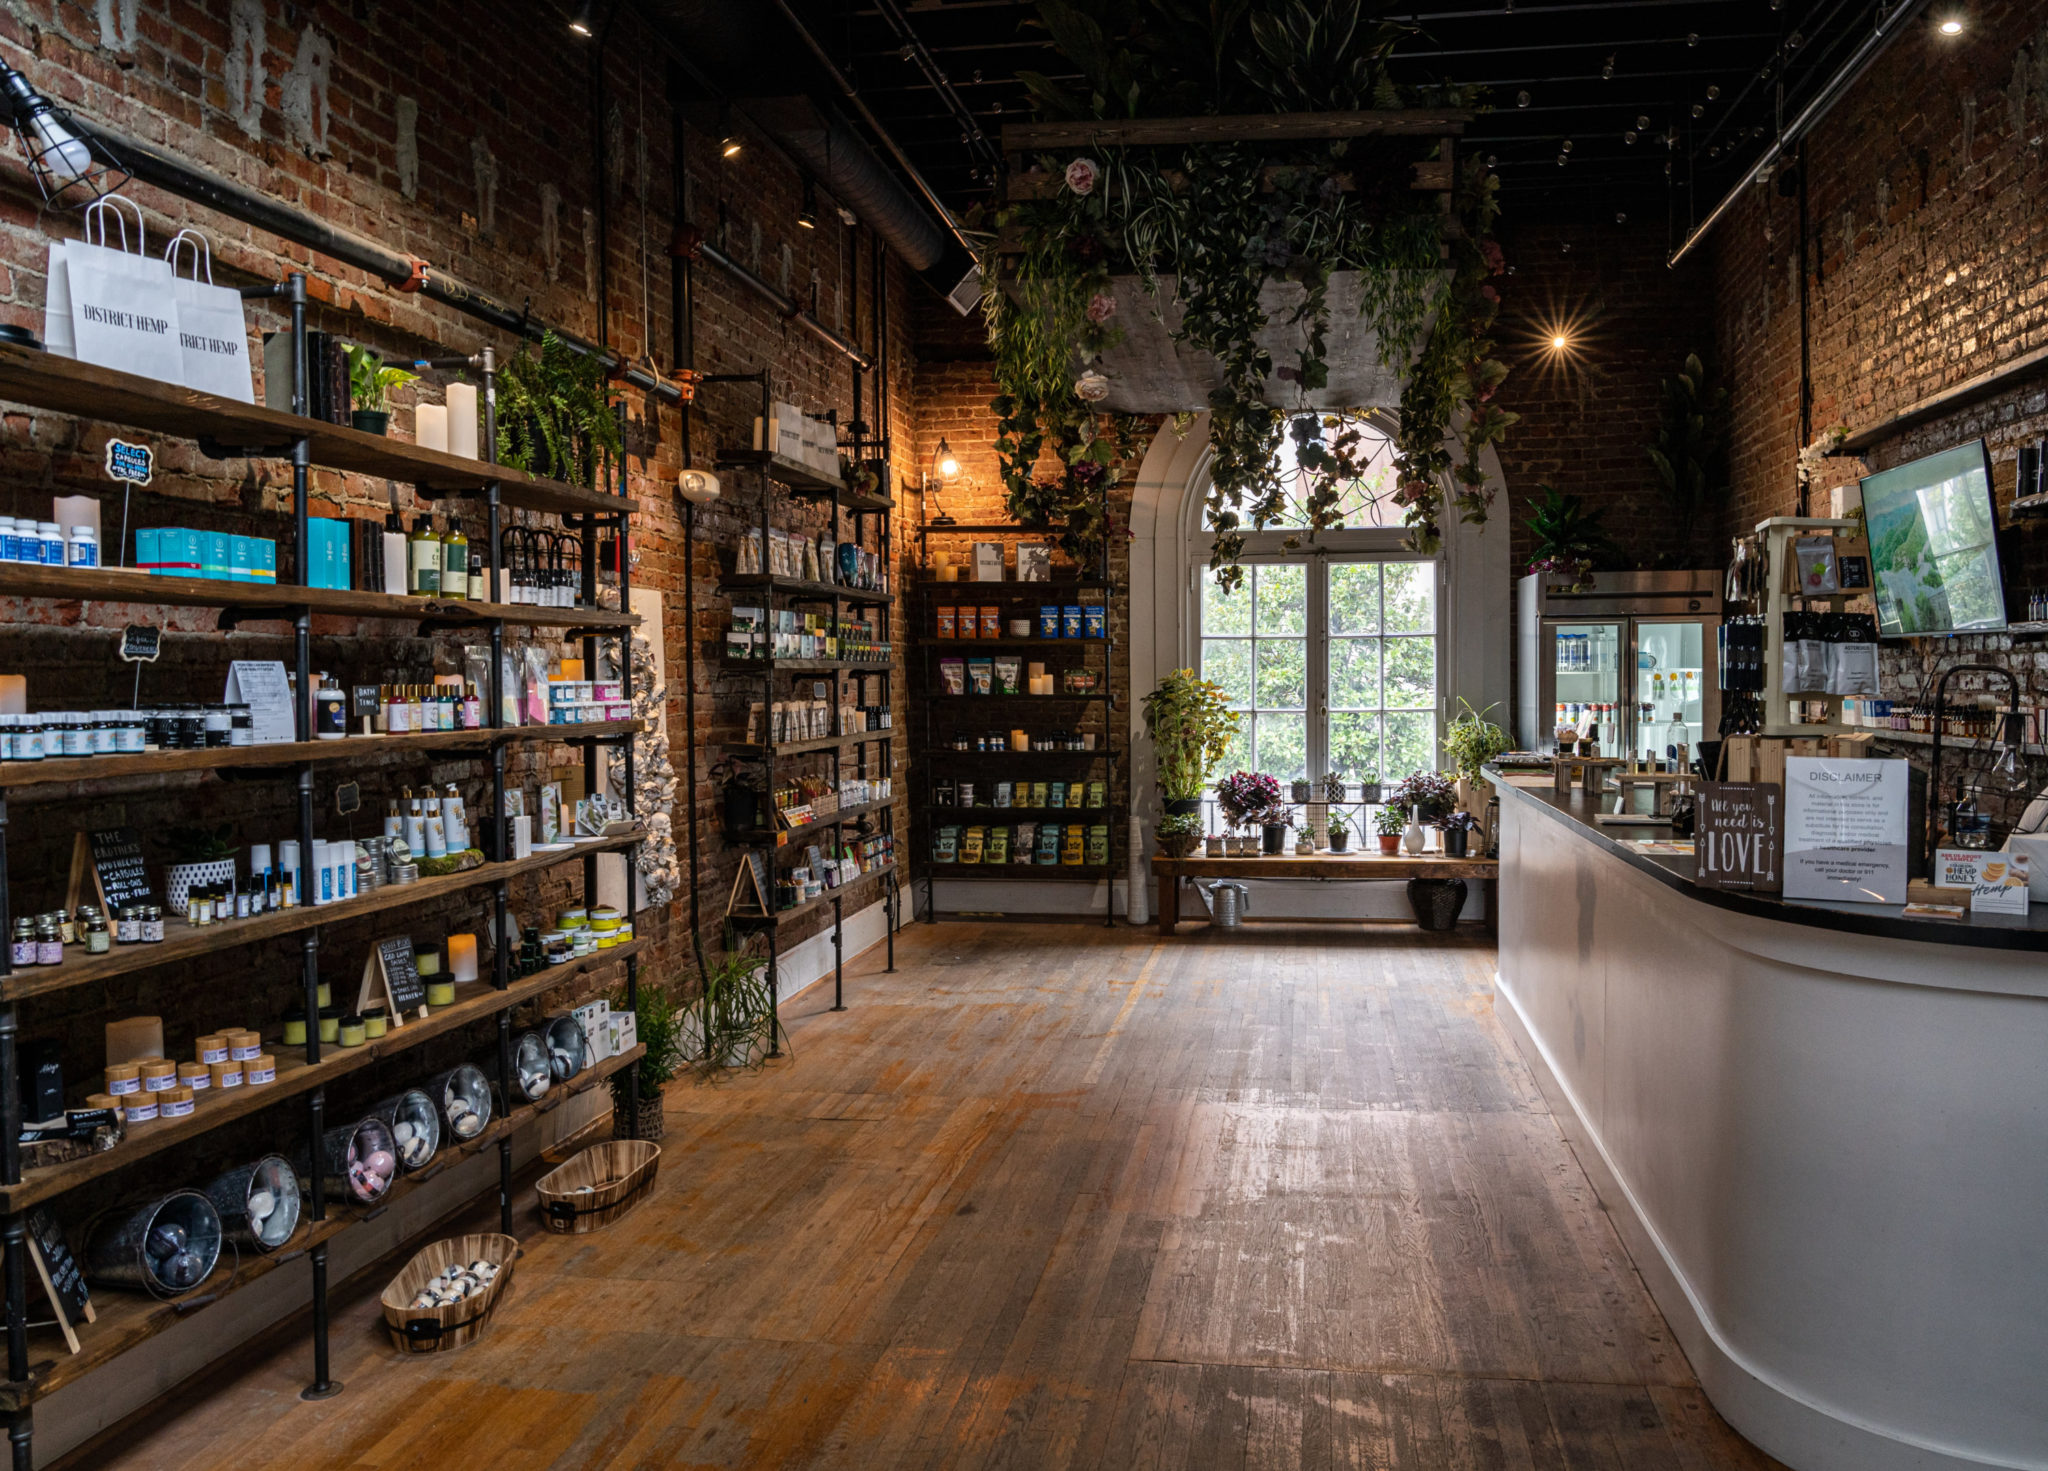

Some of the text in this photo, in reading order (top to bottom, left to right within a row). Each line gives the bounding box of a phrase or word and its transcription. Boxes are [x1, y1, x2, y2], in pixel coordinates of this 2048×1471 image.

[84, 304, 168, 334] DISTRICT HEMP
[208, 338, 238, 356] HEMP
[115, 443, 147, 459] SELECT
[358, 688, 376, 696] BATH
[1809, 771, 1883, 783] DISCLAIMER
[1711, 799, 1754, 816] All you
[1715, 814, 1765, 829] need is
[95, 831, 122, 844] THE
[1708, 831, 1766, 874] LOVE
[1945, 874, 1977, 882] HONEY
[1953, 867, 1977, 875] HEMP
[1972, 884, 2013, 898] Hemp
